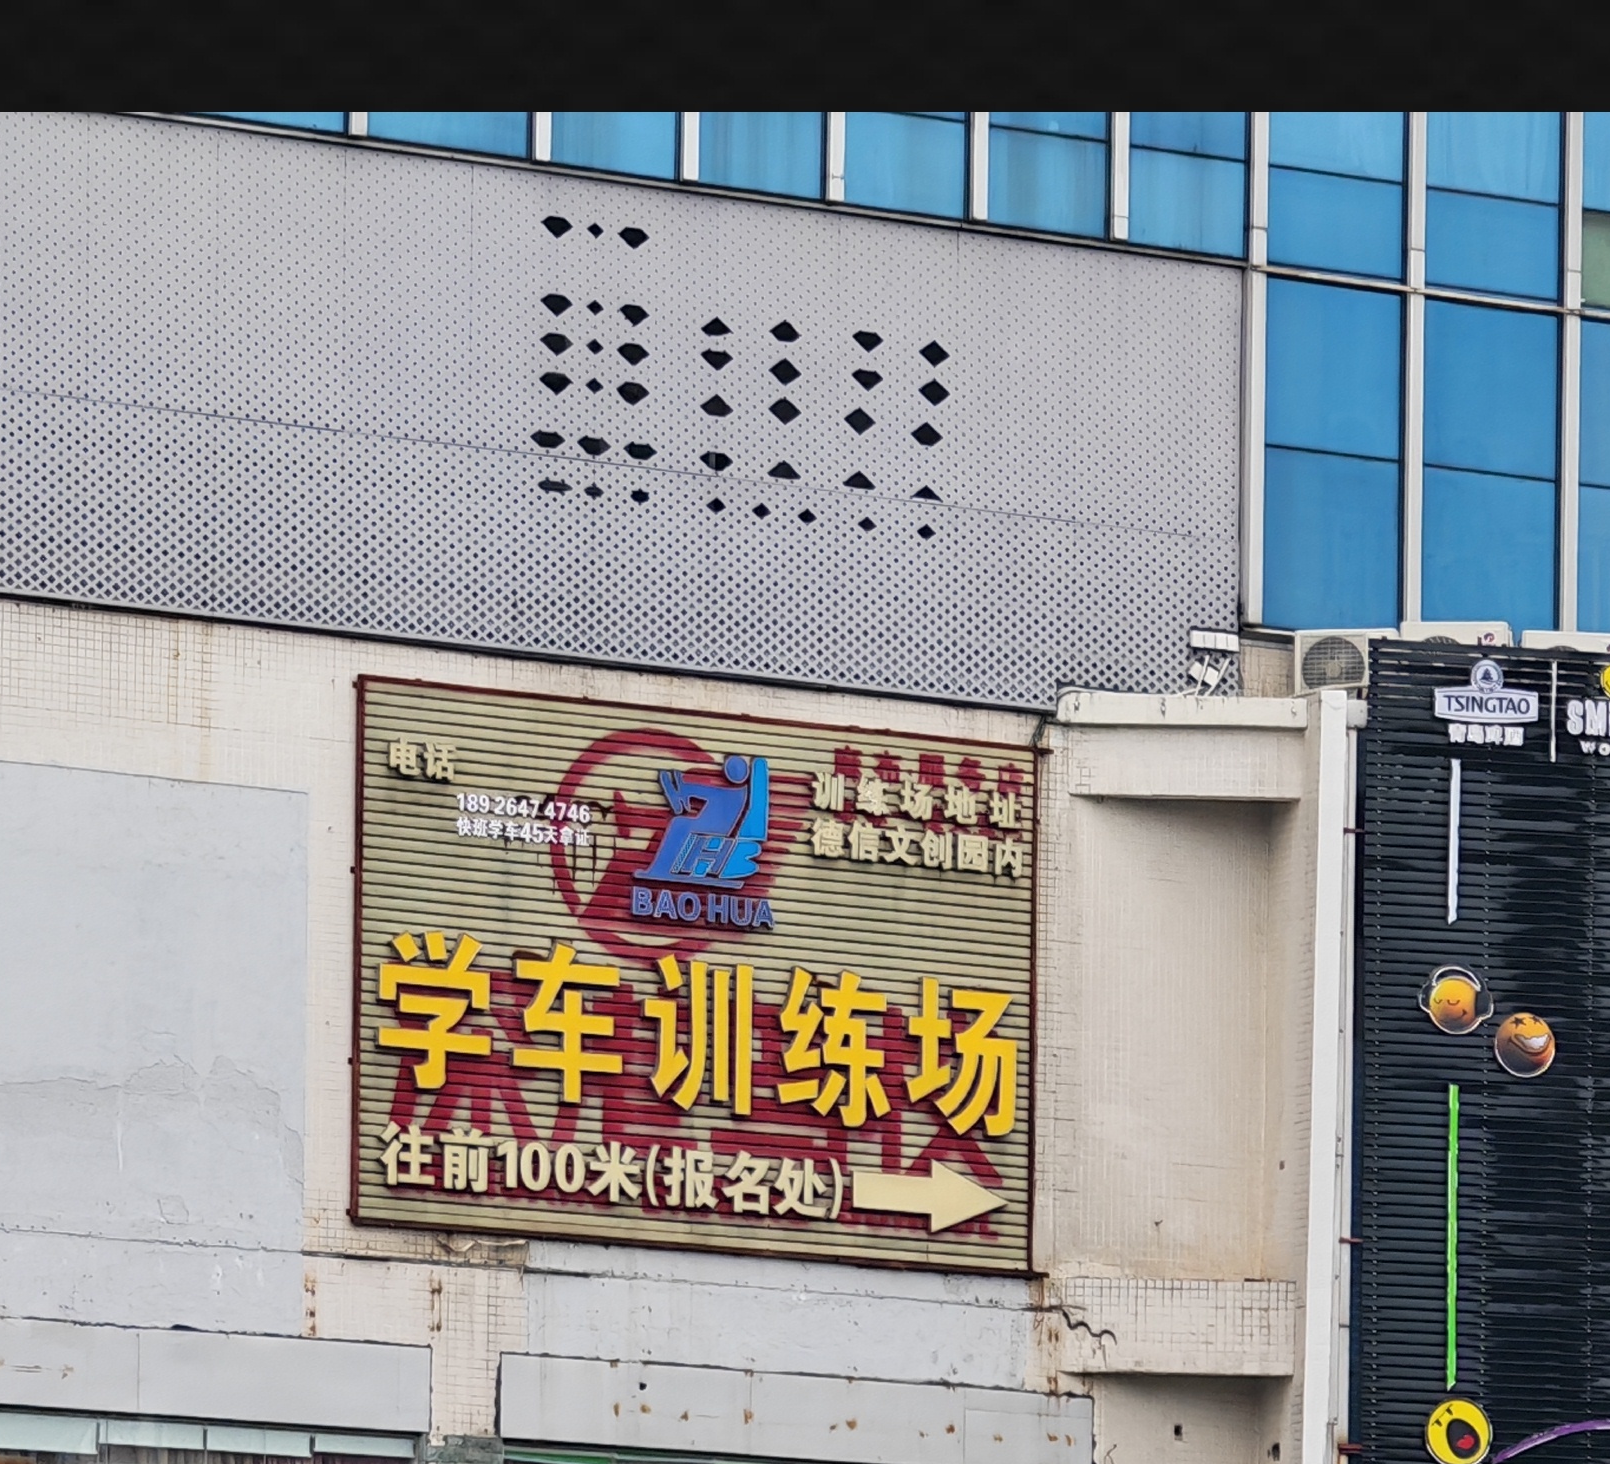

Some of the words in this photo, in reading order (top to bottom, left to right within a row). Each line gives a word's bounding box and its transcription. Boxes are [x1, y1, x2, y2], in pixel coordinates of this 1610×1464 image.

[1442, 695, 1530, 715] TSINGTAO
[389, 738, 456, 782] 电话
[456, 792, 490, 814] 189
[494, 796, 539, 821] 2647
[544, 802, 590, 824] 4746
[812, 771, 1022, 829] 训练场地址
[811, 817, 1024, 878] 德信文创园内
[631, 886, 702, 922] BAO
[707, 892, 776, 928] HUA
[378, 931, 1017, 1139] 学车训练场
[381, 1121, 845, 1220] 往前100米(报名处)
